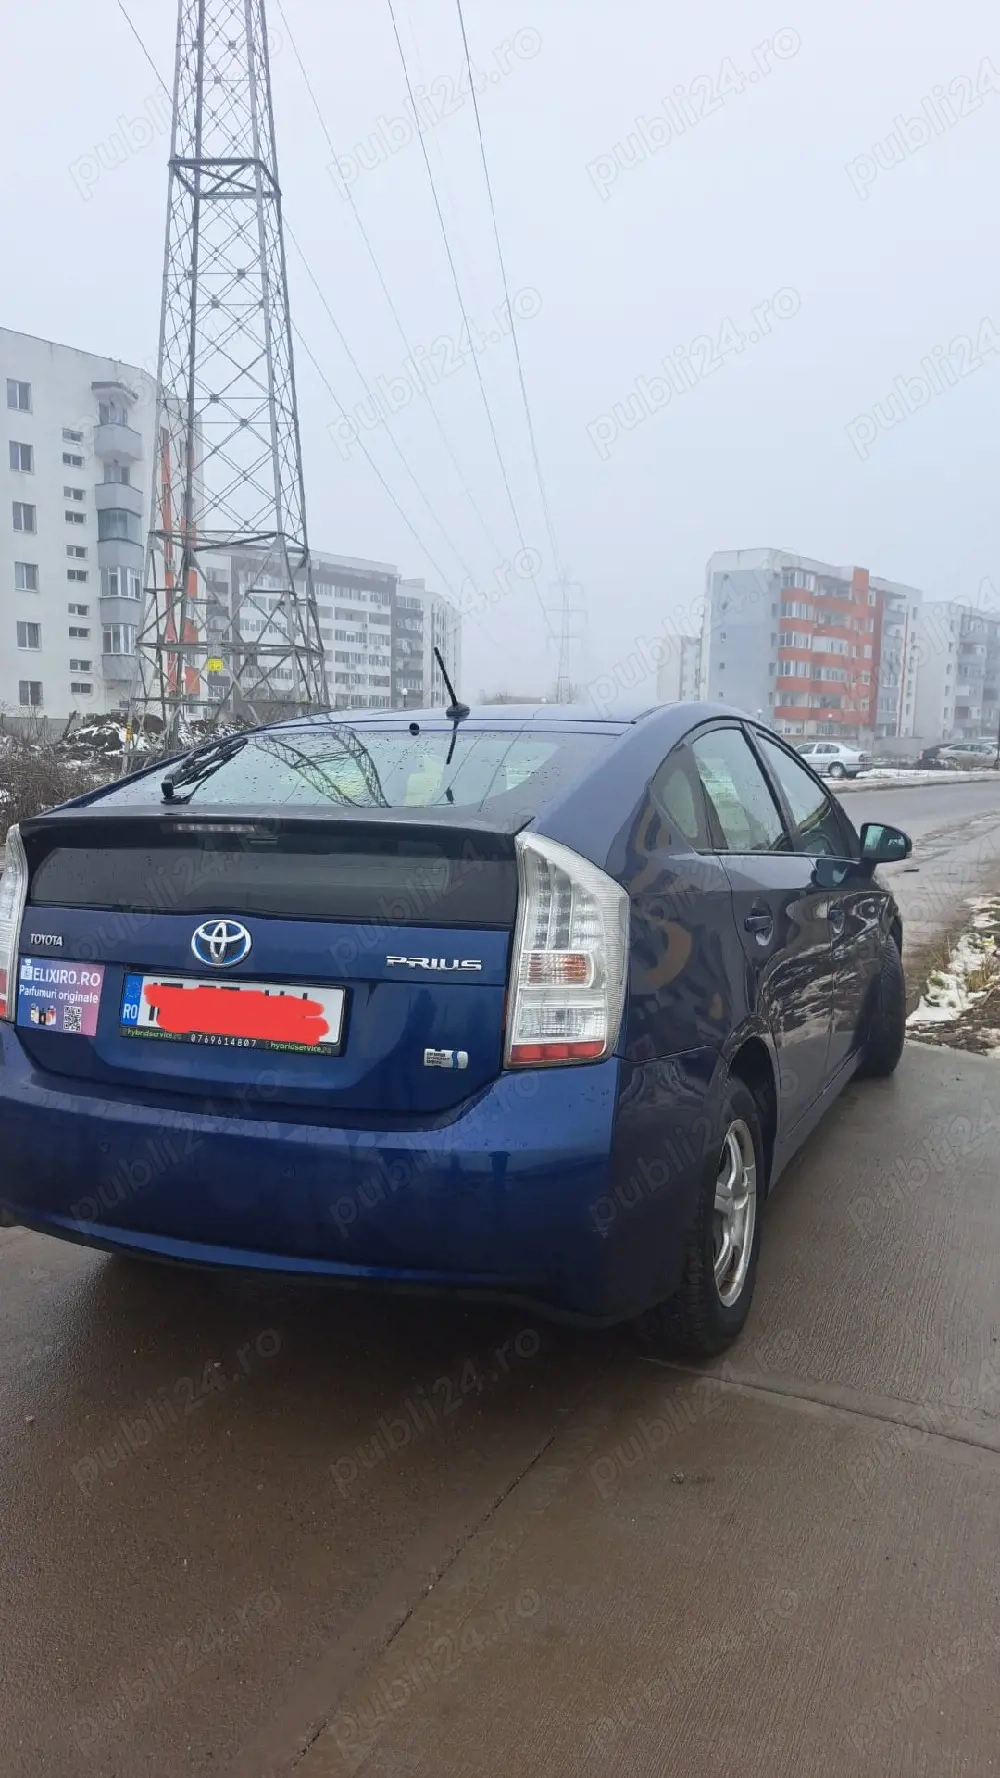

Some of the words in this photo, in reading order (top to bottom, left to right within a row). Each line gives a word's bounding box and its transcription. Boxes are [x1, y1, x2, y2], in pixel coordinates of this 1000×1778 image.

[30, 933, 63, 946] TOYOTA
[386, 955, 482, 971] PRIUS
[33, 967, 101, 987] ELIXIRO.RO
[19, 984, 57, 999] Parfumuri
[58, 988, 99, 1004] originale
[123, 1003, 137, 1019] RO
[190, 1033, 257, 1048] 0769614807
